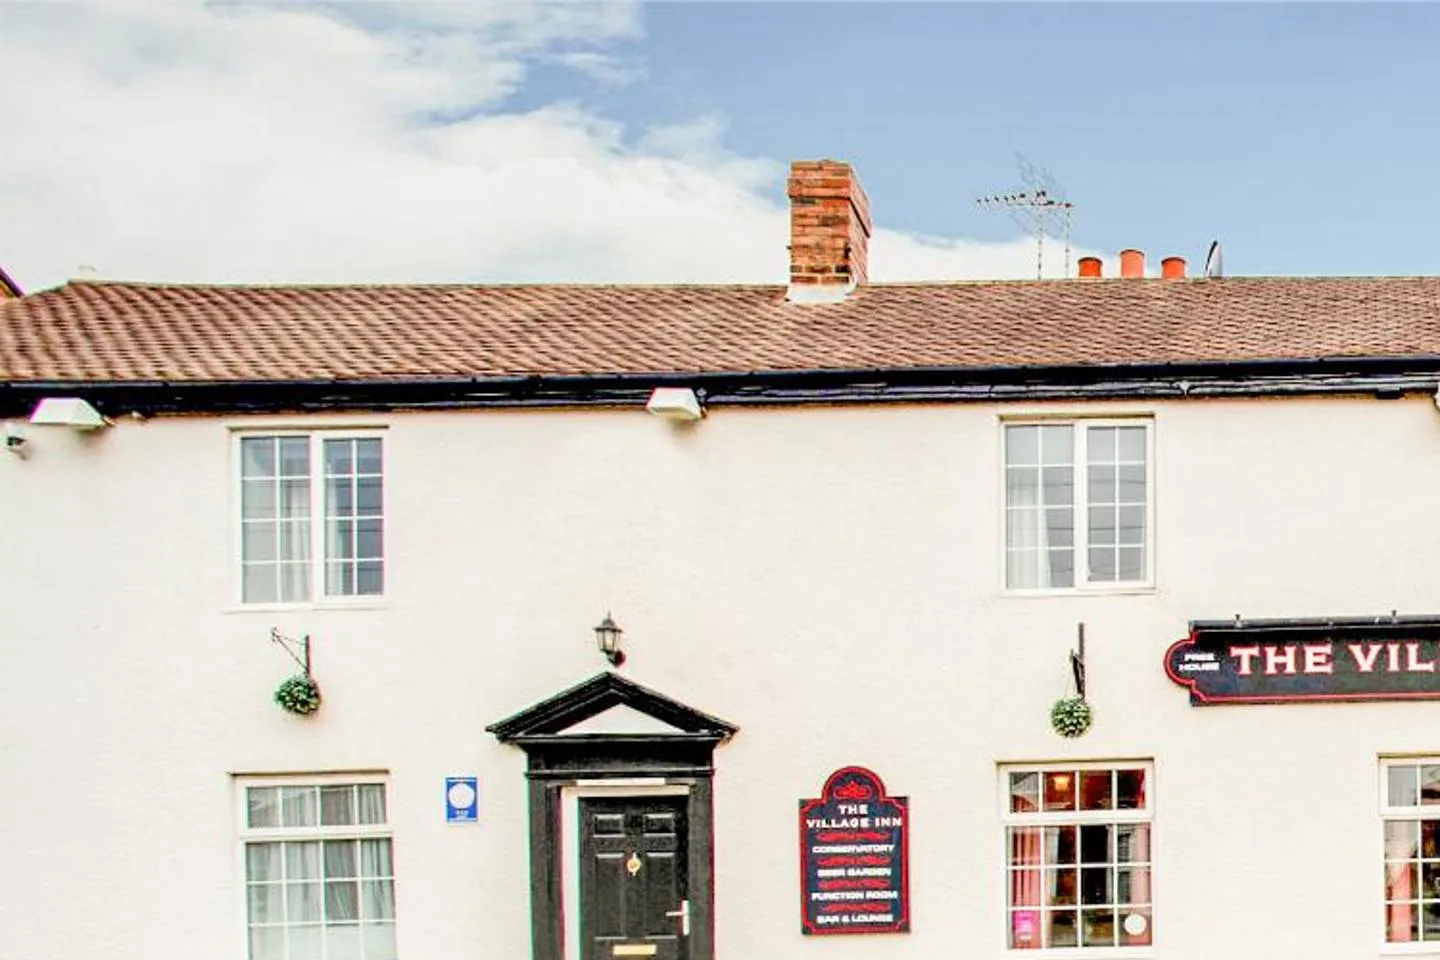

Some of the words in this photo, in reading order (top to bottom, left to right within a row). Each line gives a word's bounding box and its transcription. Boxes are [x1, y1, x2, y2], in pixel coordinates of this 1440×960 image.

[1229, 643, 1334, 676] THE
[1178, 662, 1220, 671] HOUSE
[838, 804, 868, 815] THE
[806, 818, 870, 829] VILLAGE
[875, 817, 902, 827] INN
[847, 867, 892, 877] GARDEN
[811, 891, 864, 901] FUNCTION
[865, 890, 898, 900] ROOM
[816, 915, 840, 924] BAR
[851, 913, 893, 923] LOUNGE
